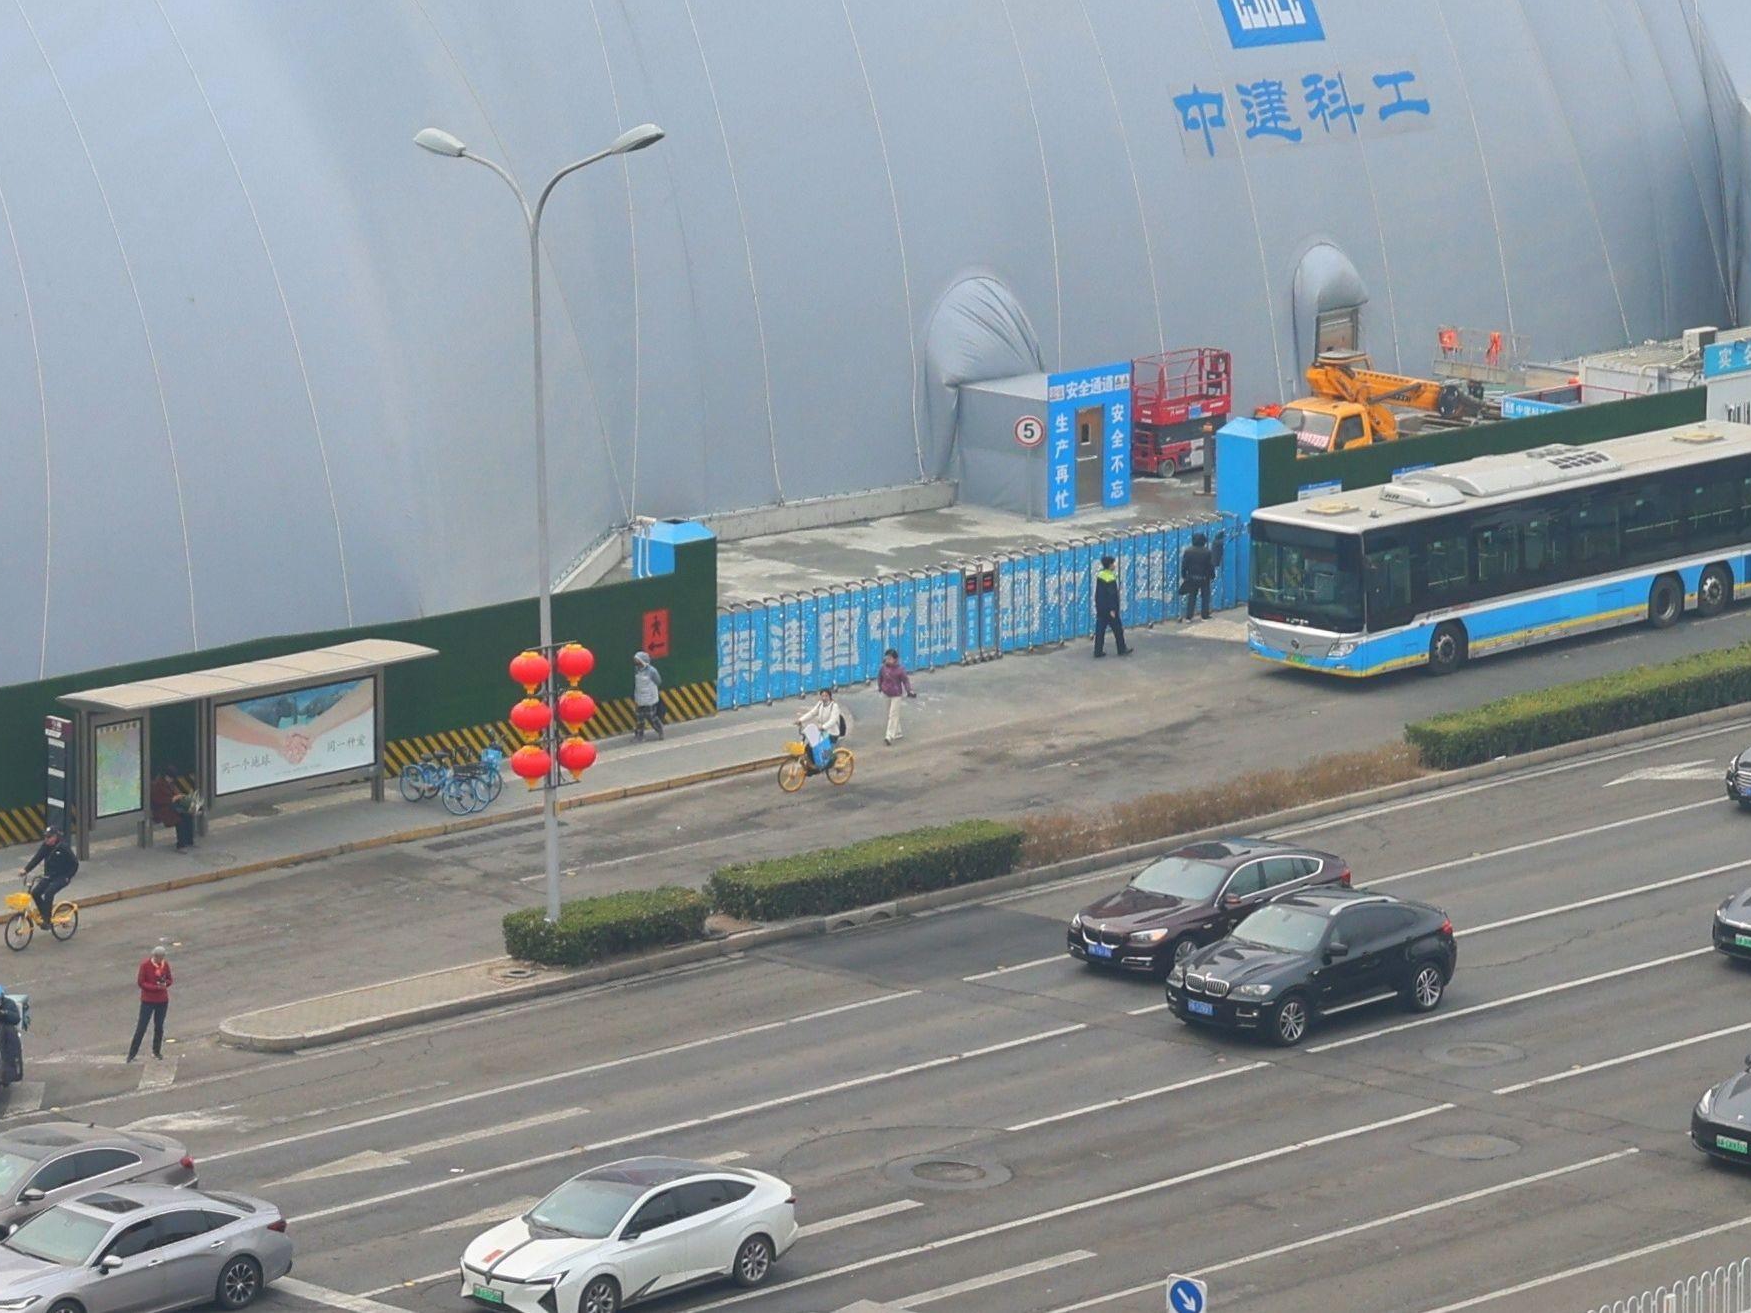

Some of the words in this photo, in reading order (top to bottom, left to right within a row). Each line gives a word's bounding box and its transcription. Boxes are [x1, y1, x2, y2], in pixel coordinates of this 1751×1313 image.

[1065, 375, 1115, 400] 安全通道
[1023, 423, 1035, 439] 5
[1110, 403, 1125, 499] 安全不忘
[1054, 413, 1069, 510] 生产再忙
